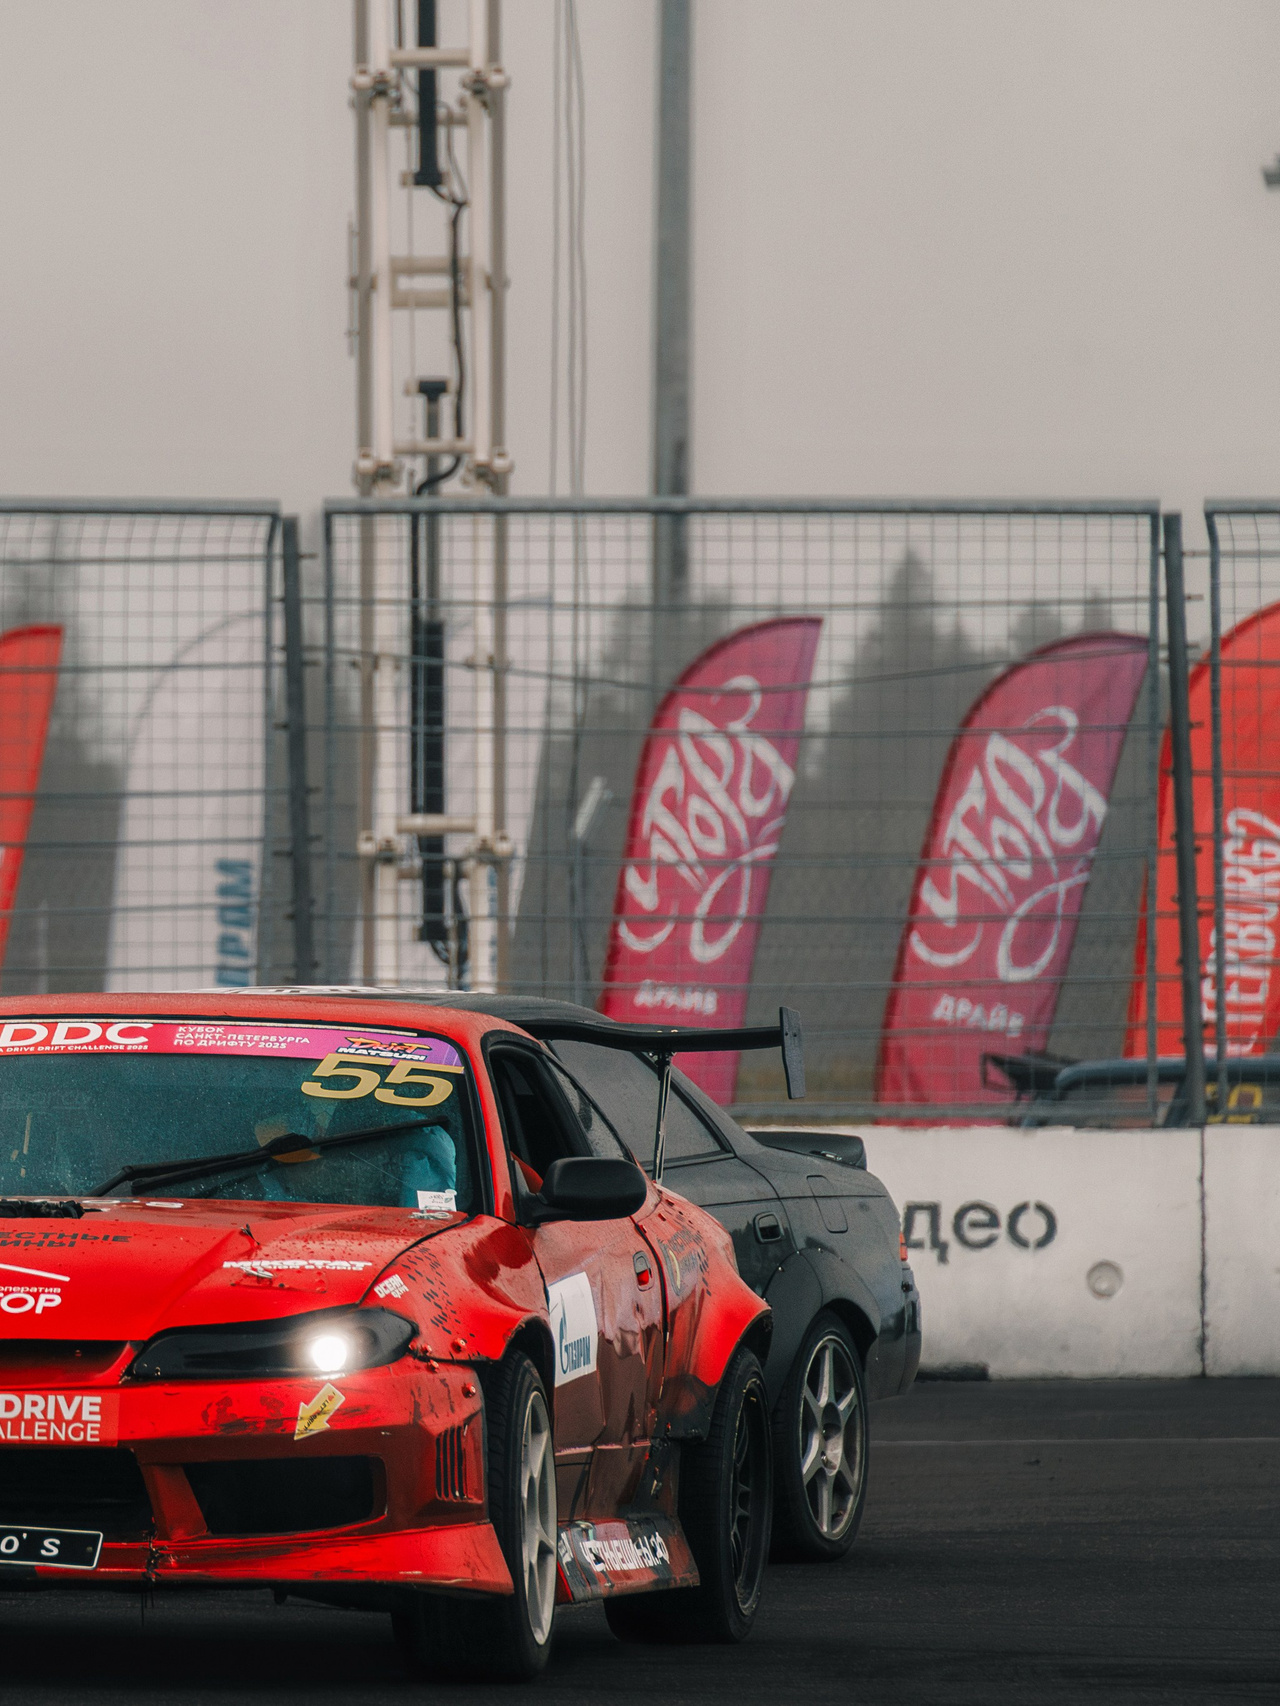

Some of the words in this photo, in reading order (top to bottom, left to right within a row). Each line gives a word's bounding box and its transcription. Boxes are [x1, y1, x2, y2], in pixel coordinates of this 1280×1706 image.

[178, 1026, 225, 1034] КУБОК
[175, 1032, 310, 1044] САНКТ-ПЕТЕРБУРГА
[196, 1040, 256, 1048] ДРИФТУ
[258, 1041, 287, 1049] 2025
[336, 1047, 427, 1061] MATSURI
[301, 1053, 465, 1107] 55
[903, 1199, 1057, 1265] део
